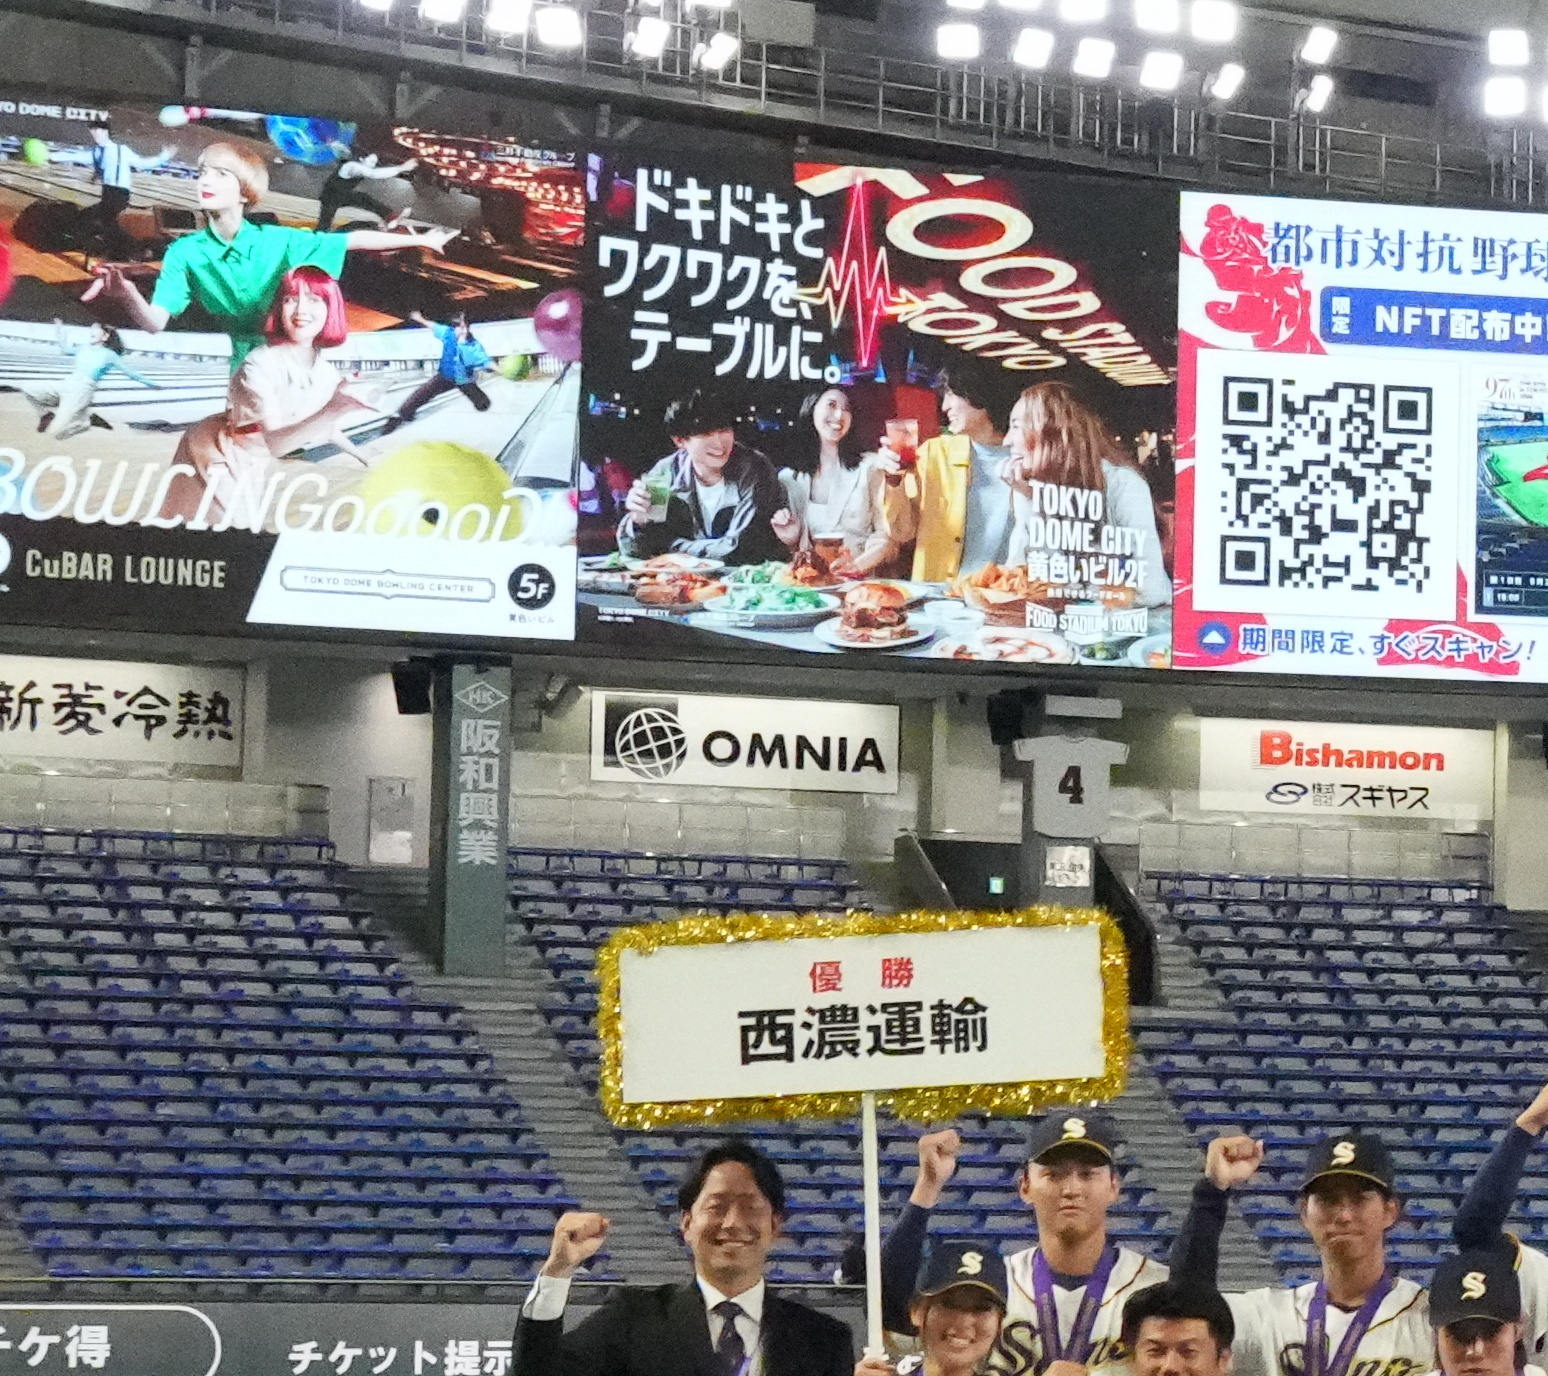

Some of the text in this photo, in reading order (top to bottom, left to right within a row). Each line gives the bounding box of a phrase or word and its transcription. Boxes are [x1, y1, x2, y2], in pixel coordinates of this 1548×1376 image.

[19, 103, 109, 122] DOME CITY
[635, 168, 825, 259] ドキドキと
[1331, 296, 1351, 335] 限定
[630, 309, 842, 385] テーブルに。
[1029, 479, 1103, 521] TOKYO
[1029, 515, 1148, 557] DOME CITY
[25, 548, 227, 589] CuBAR LOUNGE
[303, 575, 475, 594] TOKYO DOME BOWLING CENTER
[516, 571, 550, 601] 5F
[1027, 550, 1149, 589] 黄色いビル2F
[509, 613, 556, 624] 黄色いビル
[1241, 625, 1536, 664] 期間限定、すぐスキャン!
[0, 680, 234, 741] 新菱冷熱
[702, 729, 887, 775] OMNIA
[1258, 728, 1446, 772] Bishamon
[457, 718, 502, 865] 阪和興業
[1058, 765, 1085, 805] 4
[1338, 782, 1430, 811] スギヤス
[808, 956, 915, 994] 優勝
[737, 996, 989, 1066] 西濃運輸
